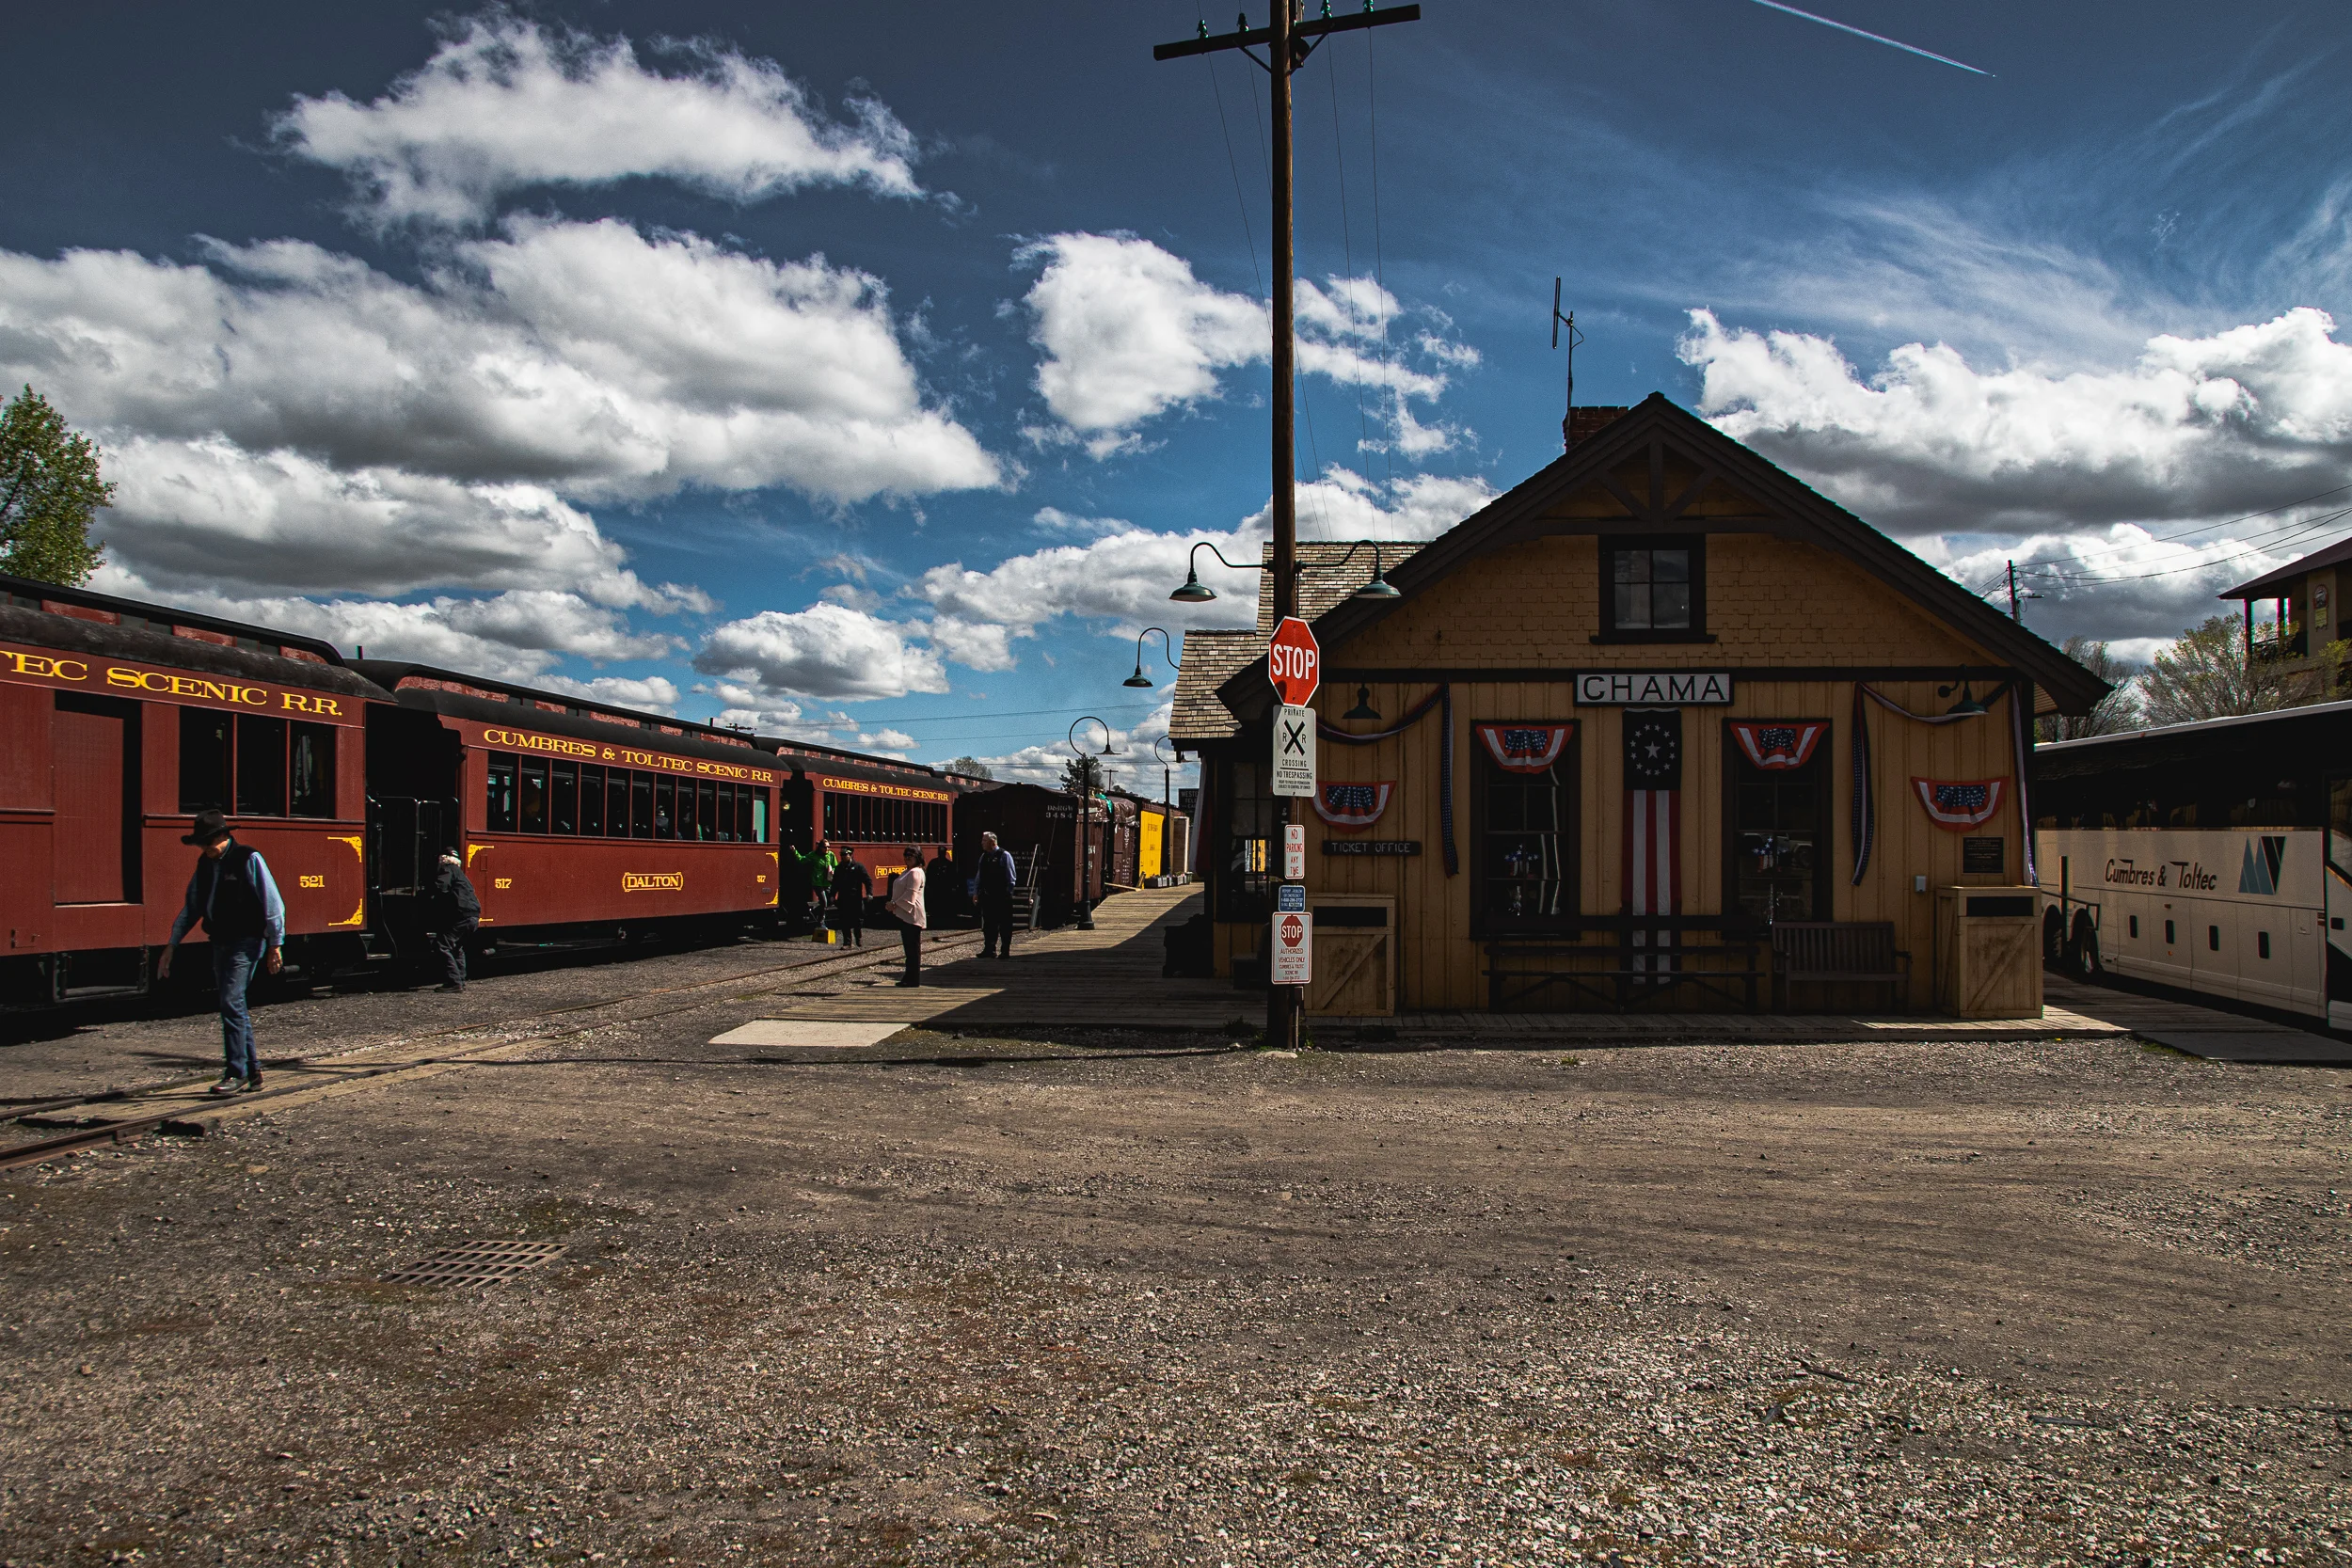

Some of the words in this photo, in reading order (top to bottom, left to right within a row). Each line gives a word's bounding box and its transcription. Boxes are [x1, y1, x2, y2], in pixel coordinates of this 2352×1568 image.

[1273, 643, 1316, 680] STOP
[106, 667, 267, 705] SCENIC
[280, 692, 342, 717] R.R.
[1583, 674, 1725, 702] CHAMA
[1284, 708, 1305, 717] PRIVATE
[1283, 732, 1287, 742] R
[1302, 734, 1306, 744] R
[484, 729, 596, 757] CUMBRES
[602, 747, 615, 761] &
[621, 750, 692, 772] TOLTEC
[696, 761, 748, 779] SCENIC
[752, 769, 773, 783] R.R.
[1282, 759, 1307, 767] CROSSING
[1277, 770, 1283, 779] NO
[1283, 771, 1313, 780] TRESPASSING
[823, 778, 869, 792] CUMBRES
[870, 784, 877, 793] &
[879, 784, 911, 797] TOLTEC
[913, 789, 938, 800] SCENIC
[1291, 830, 1298, 840] NO
[1286, 843, 1303, 853] PARKING
[1331, 842, 1369, 853] TICKET
[1375, 842, 1411, 853] OFFICE
[1290, 856, 1298, 864] ANY
[877, 867, 888, 876] RIO
[1290, 866, 1299, 875] TIME
[2105, 858, 2155, 886] Cumbres
[2157, 864, 2167, 887] &
[2169, 861, 2217, 891] Toltec
[299, 875, 326, 888] 521
[494, 878, 513, 889] 517
[627, 875, 679, 888] DALTON
[1282, 925, 1303, 938] STOP
